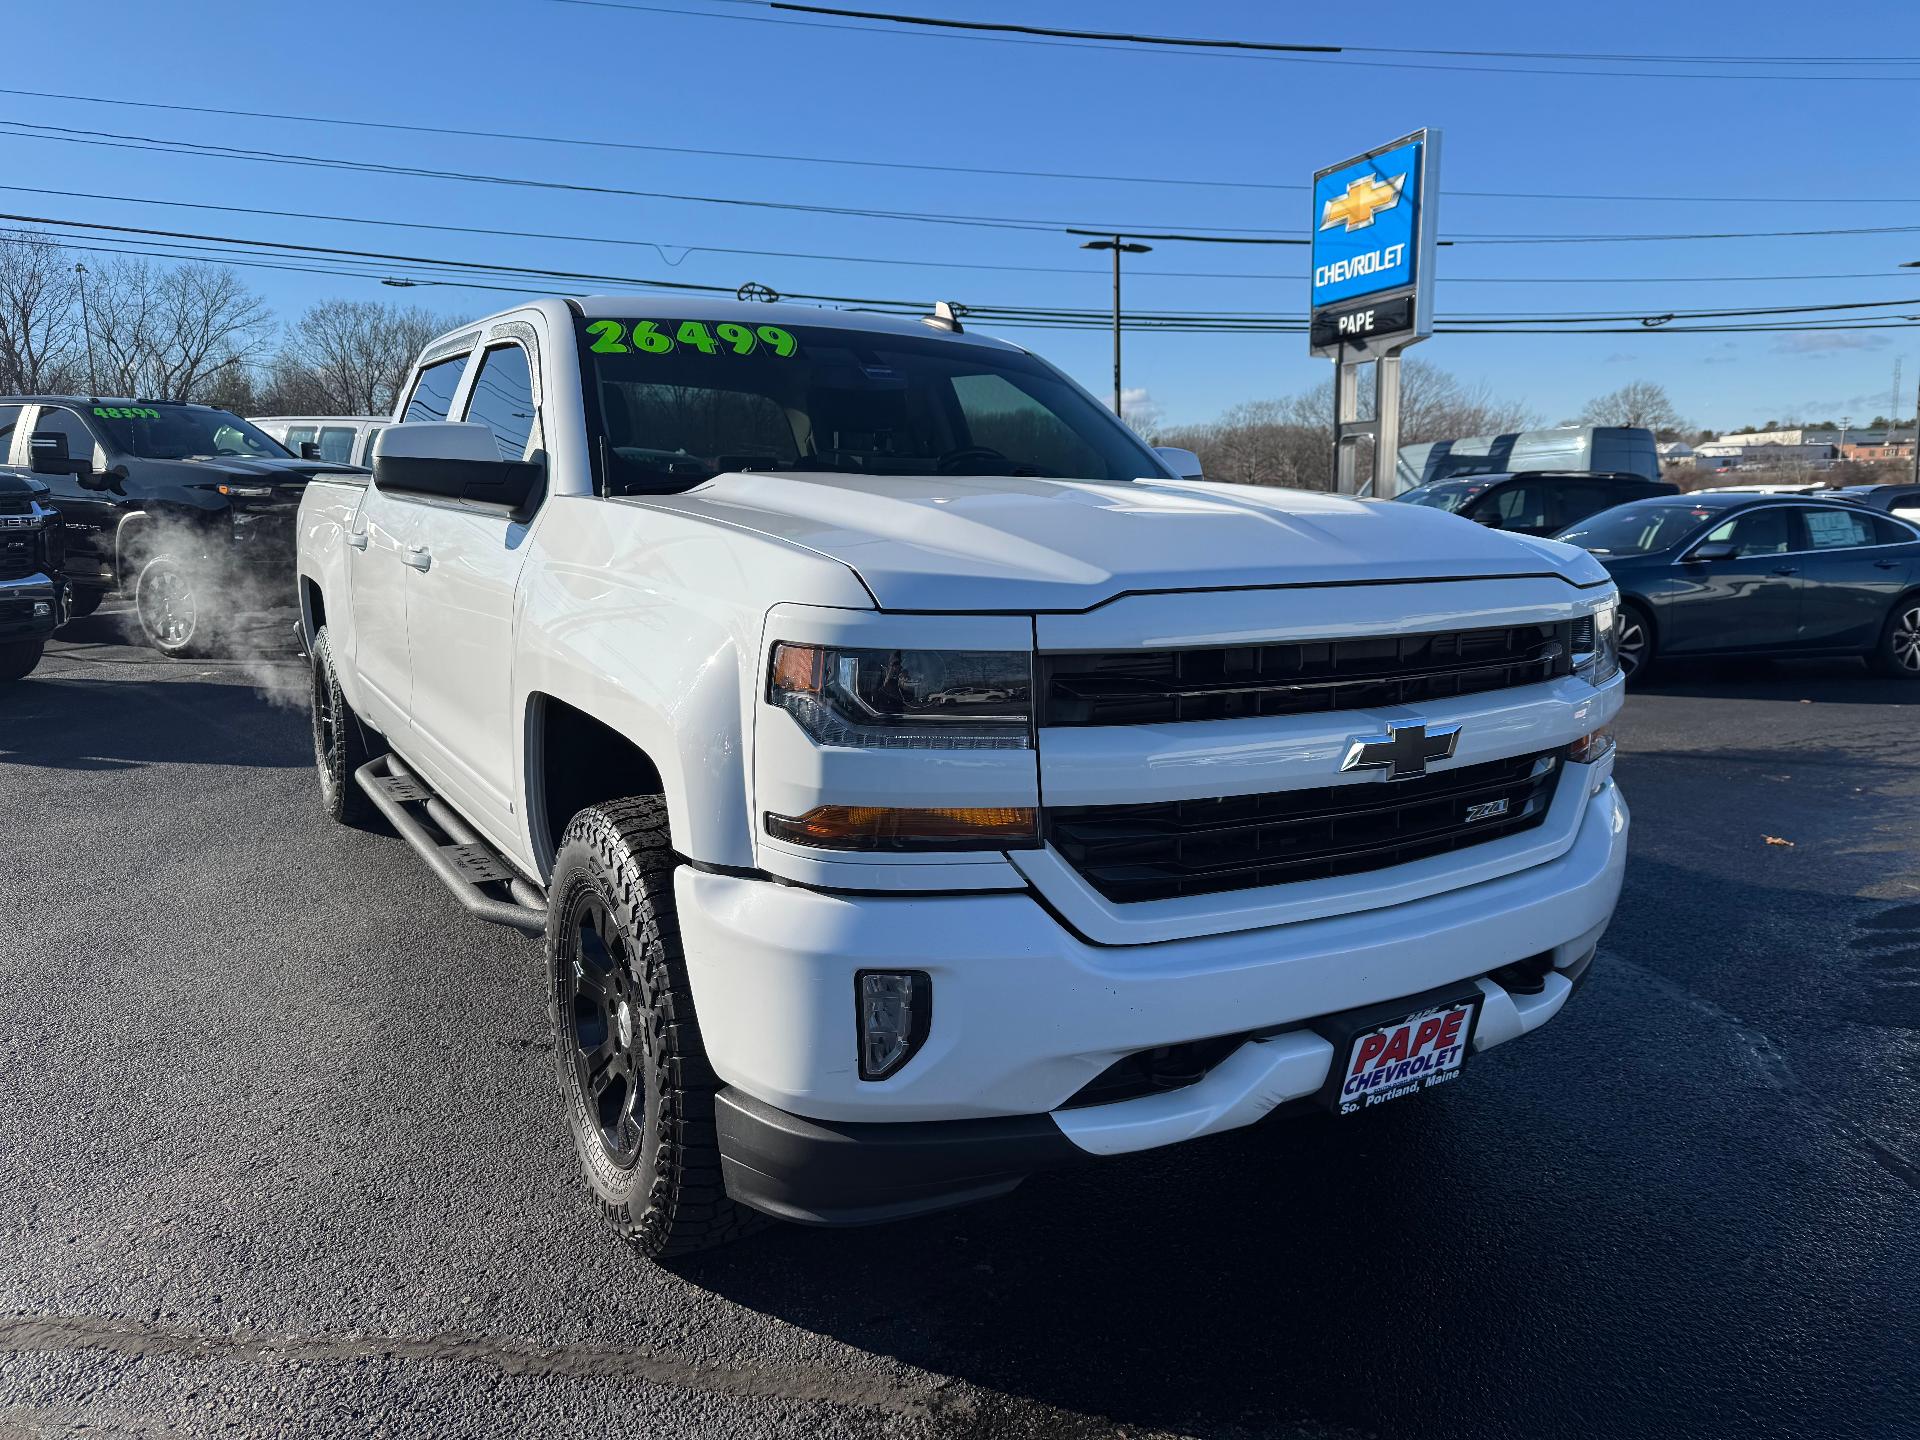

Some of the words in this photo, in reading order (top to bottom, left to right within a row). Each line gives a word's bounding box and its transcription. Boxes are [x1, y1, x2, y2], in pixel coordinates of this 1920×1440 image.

[1315, 243, 1406, 288] CHEVROLET
[585, 319, 798, 358] 26499
[1338, 310, 1375, 336] PAPE
[93, 407, 161, 419] 48399
[1351, 1008, 1467, 1076] PAPE
[1343, 1043, 1463, 1096] CHEVROLET
[1365, 1081, 1420, 1109] Portland,
[1425, 1069, 1460, 1089] Maine
